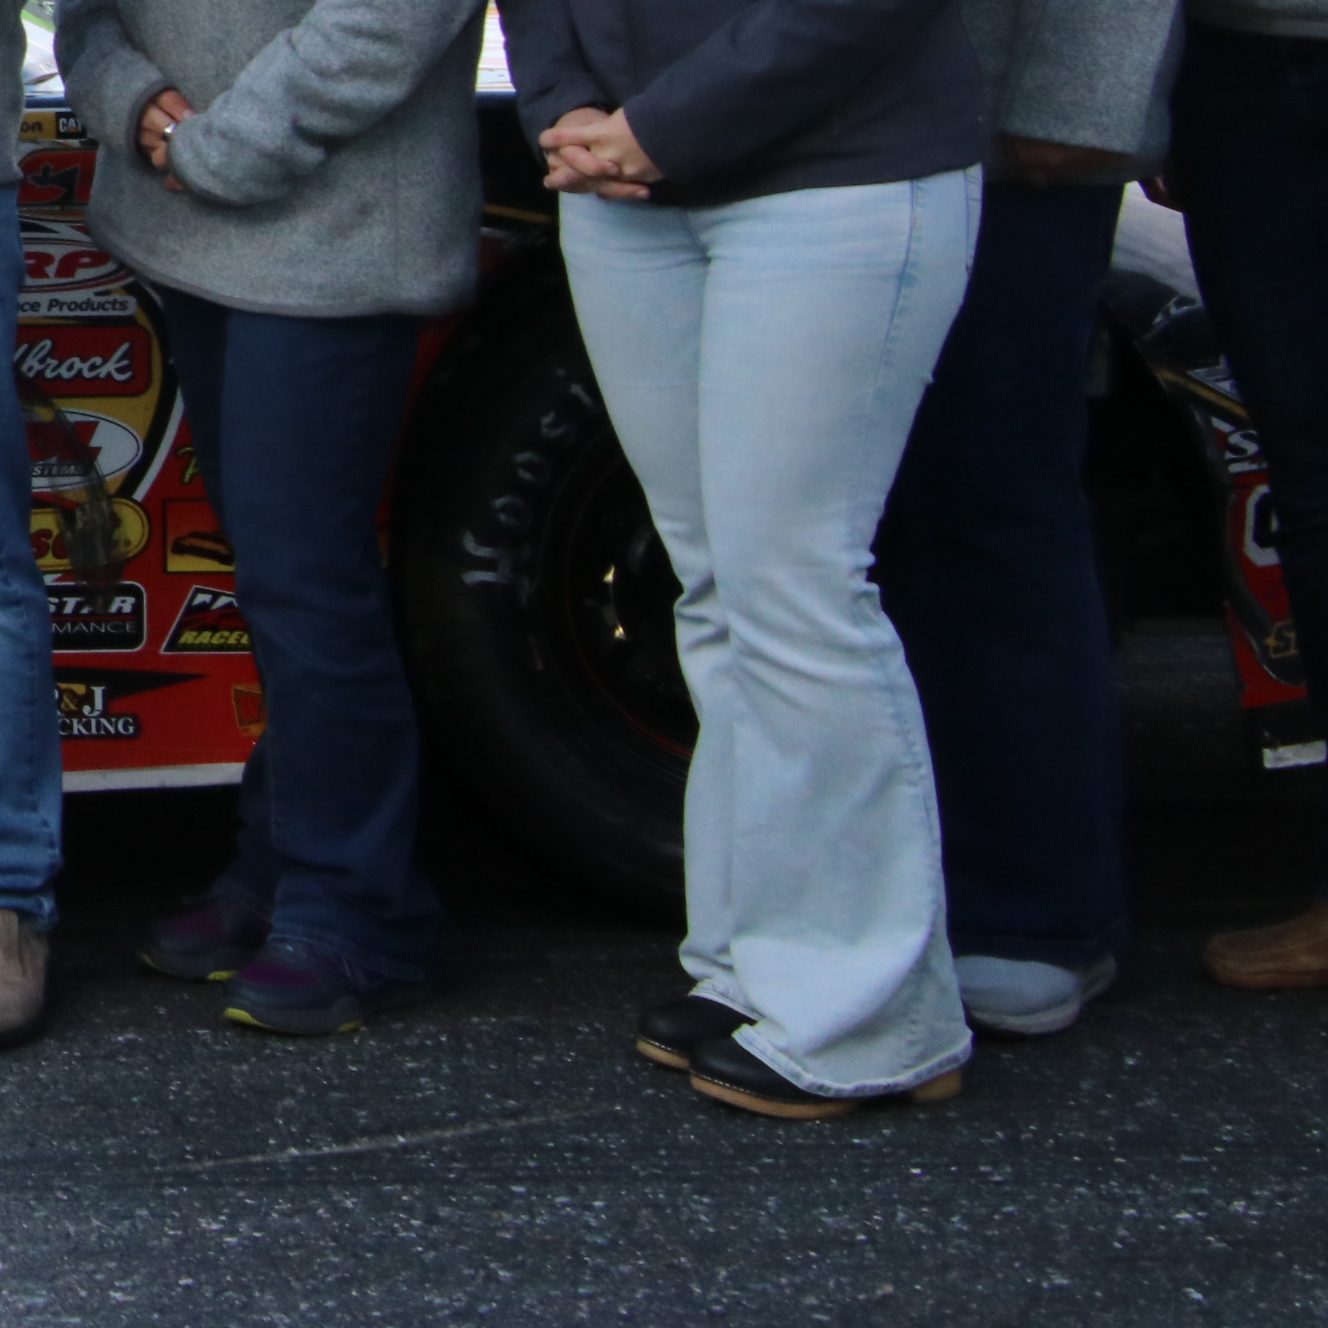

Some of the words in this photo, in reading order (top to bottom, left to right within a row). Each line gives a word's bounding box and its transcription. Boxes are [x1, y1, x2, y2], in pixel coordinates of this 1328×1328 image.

[25, 249, 111, 279] RP
[47, 298, 129, 313] Products
[59, 717, 136, 736] CKING
